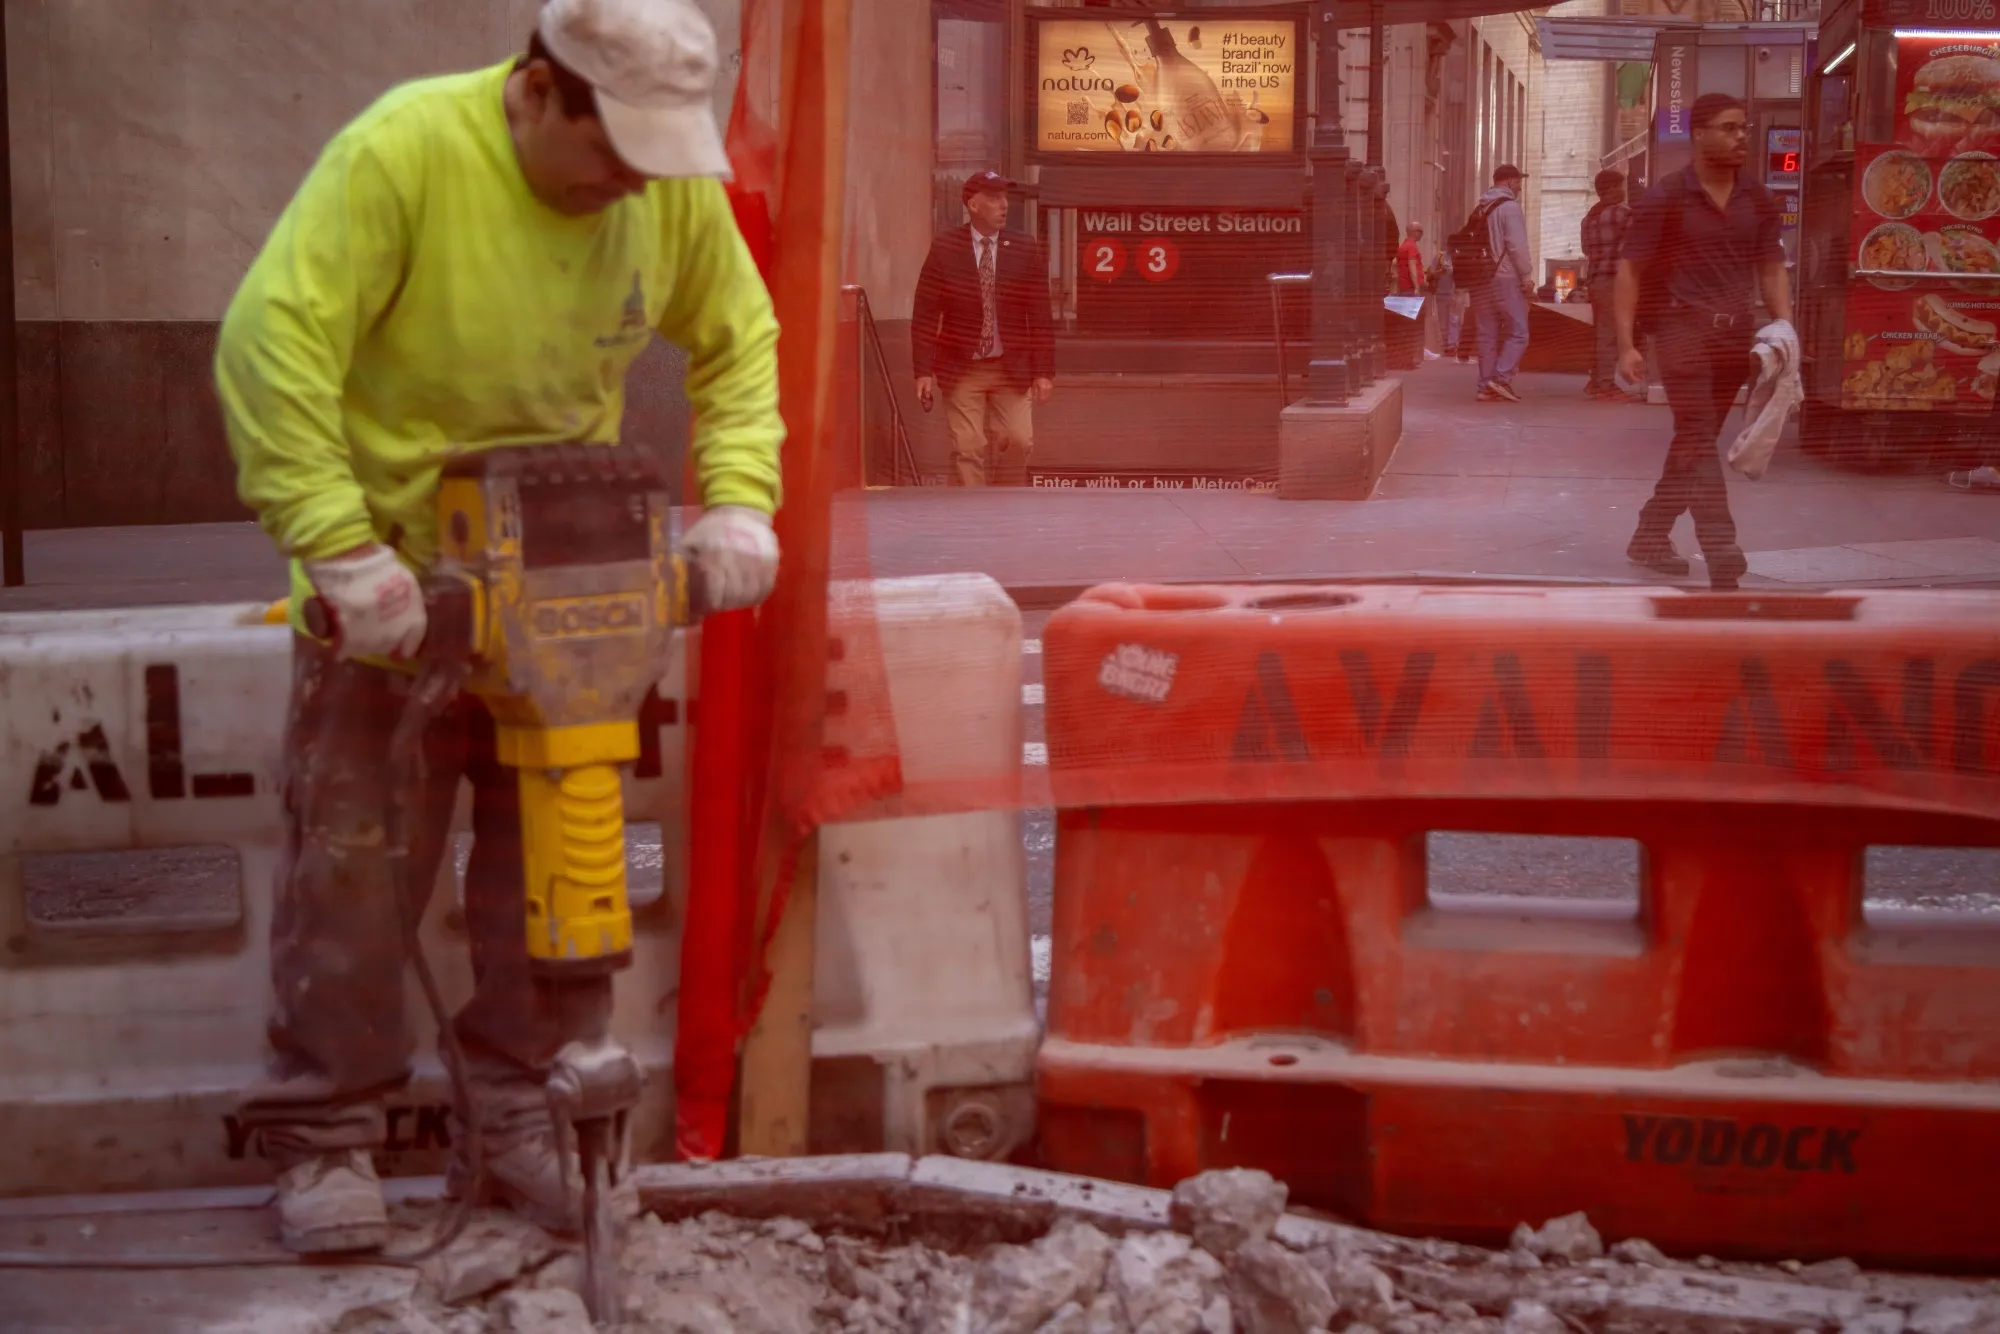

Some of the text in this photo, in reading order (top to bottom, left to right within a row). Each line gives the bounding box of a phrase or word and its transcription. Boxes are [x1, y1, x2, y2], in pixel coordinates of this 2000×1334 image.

[1223, 33, 1286, 48] #1 beauty
[1222, 47, 1275, 60] brand in
[1262, 64, 1292, 74] now
[1042, 77, 1115, 92] natura
[1221, 75, 1280, 88] in the US
[1669, 46, 1685, 134] Newsstand
[1047, 129, 1108, 141] natura.com
[1083, 211, 1301, 233] Wall Street Station
[1095, 246, 1167, 273] 2 3
[1881, 331, 1938, 340] CHICKEN KEBAB
[1032, 475, 1078, 488] Enter
[1085, 477, 1121, 489] with
[1128, 479, 1146, 489] or
[1153, 477, 1185, 489] buy
[1620, 1113, 1861, 1175] YODOCK
